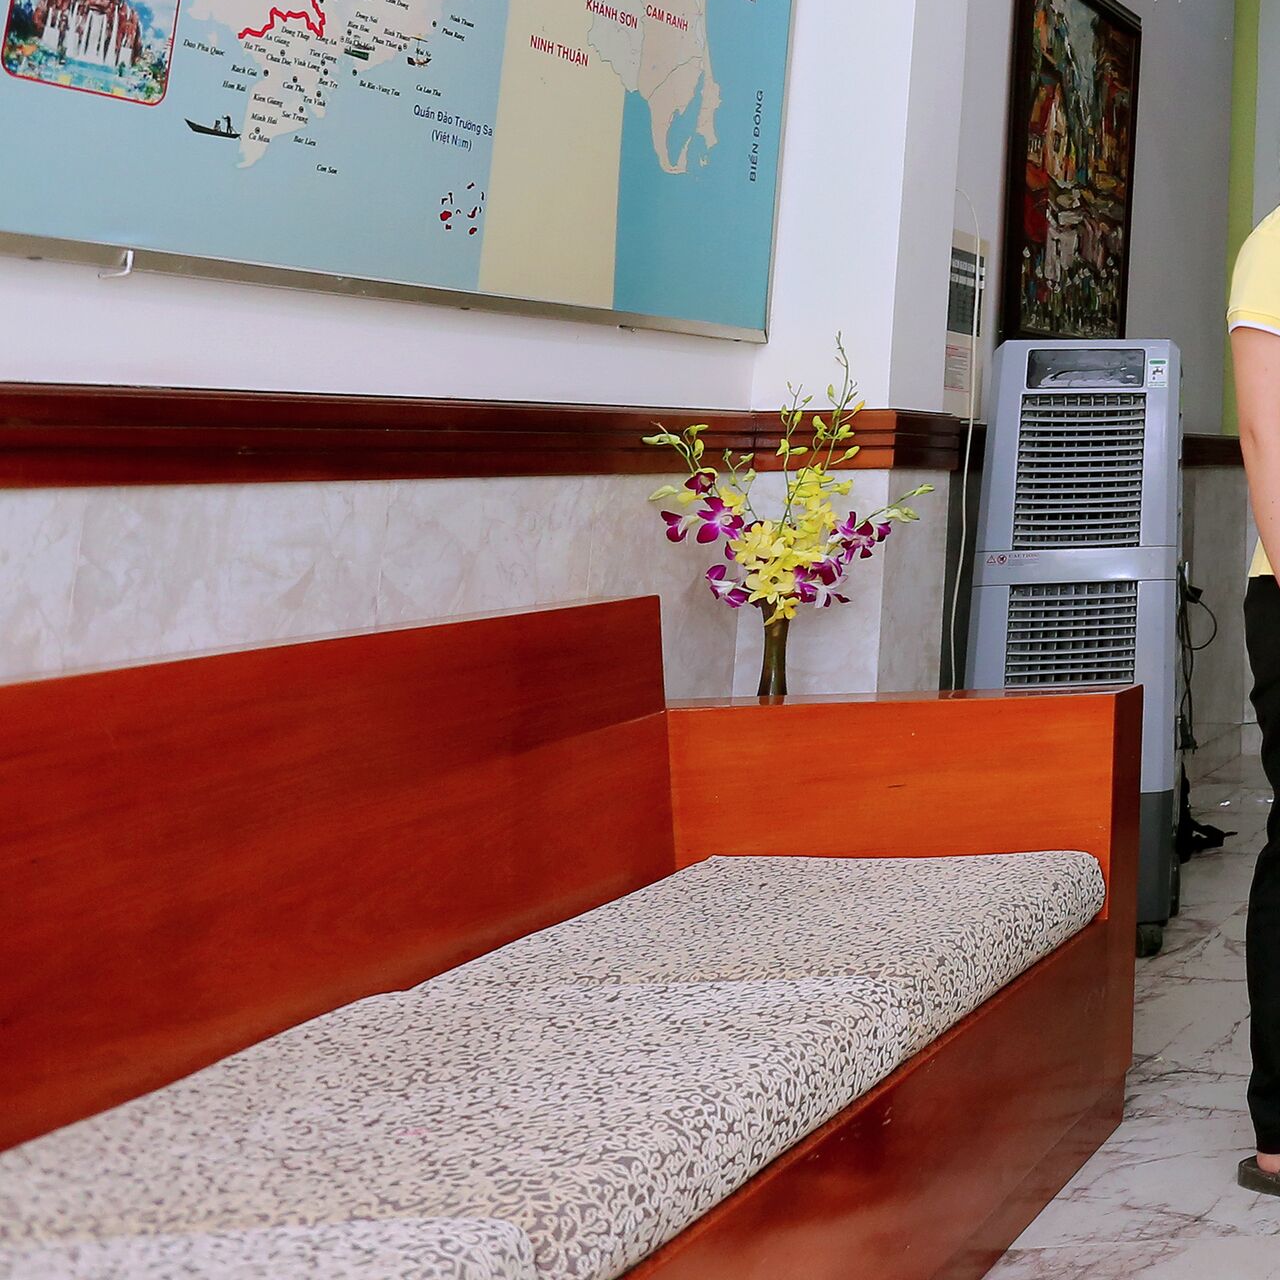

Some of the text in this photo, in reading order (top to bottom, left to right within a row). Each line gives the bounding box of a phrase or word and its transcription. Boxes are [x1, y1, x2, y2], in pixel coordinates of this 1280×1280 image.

[645, 4, 688, 32] CAM RANH
[530, 34, 555, 55] NINH
[482, 124, 493, 137] Sa
